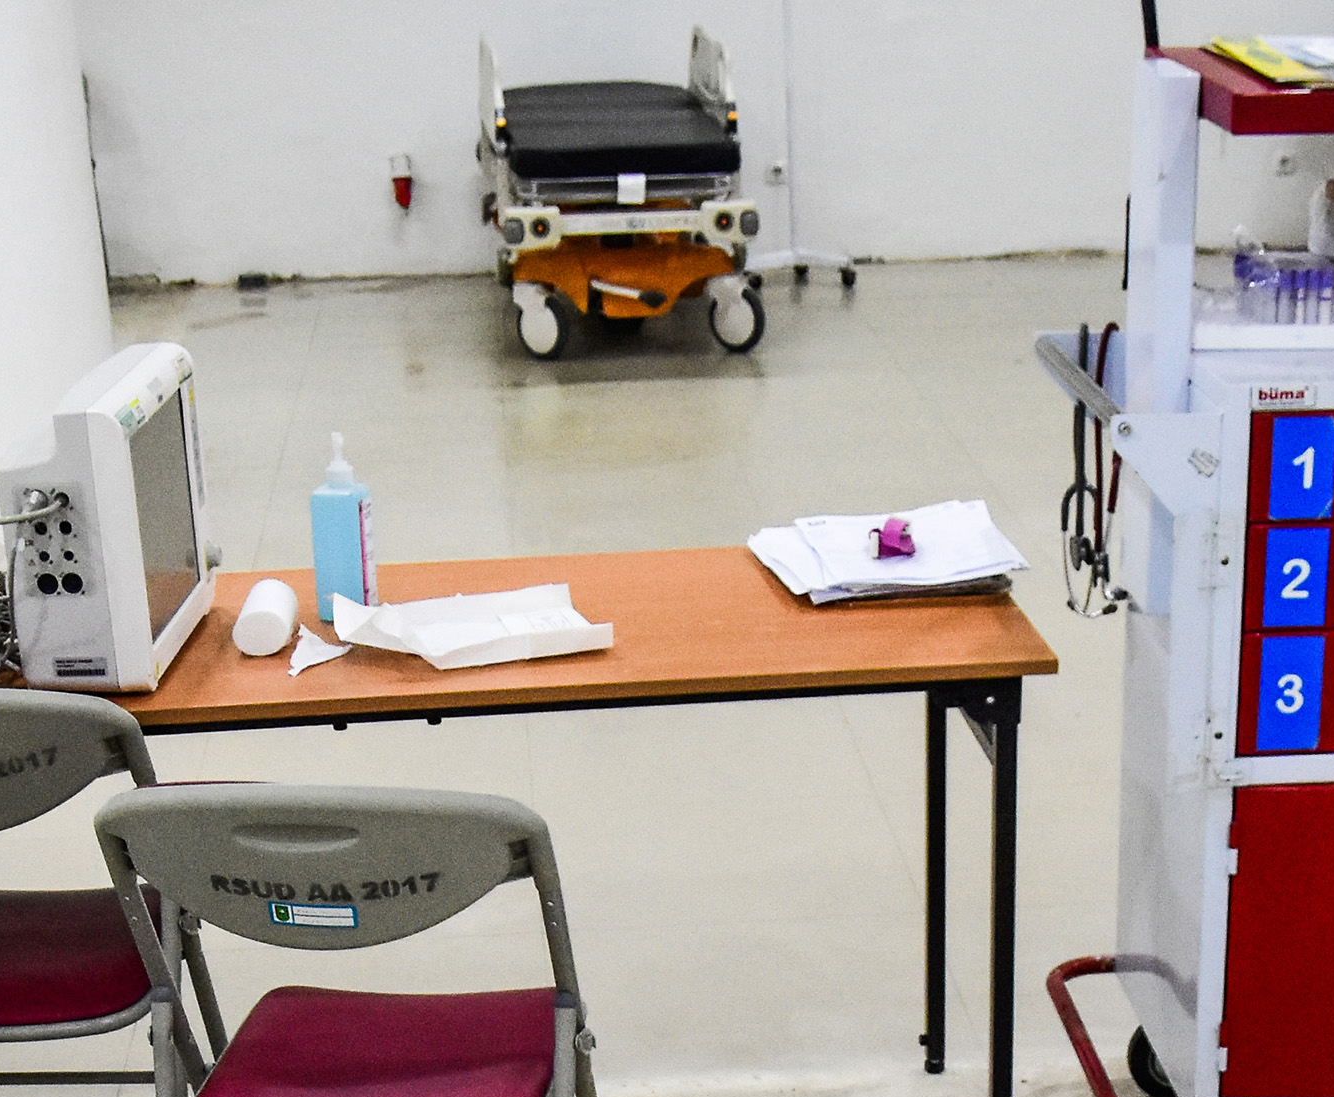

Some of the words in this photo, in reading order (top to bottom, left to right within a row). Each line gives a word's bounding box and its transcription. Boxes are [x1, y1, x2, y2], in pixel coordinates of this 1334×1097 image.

[1292, 446, 1315, 489] 1
[1281, 558, 1311, 599] 2
[1275, 674, 1304, 714] 3
[210, 874, 296, 901] RSUD
[308, 883, 353, 902] AA
[362, 871, 441, 901] 2017
